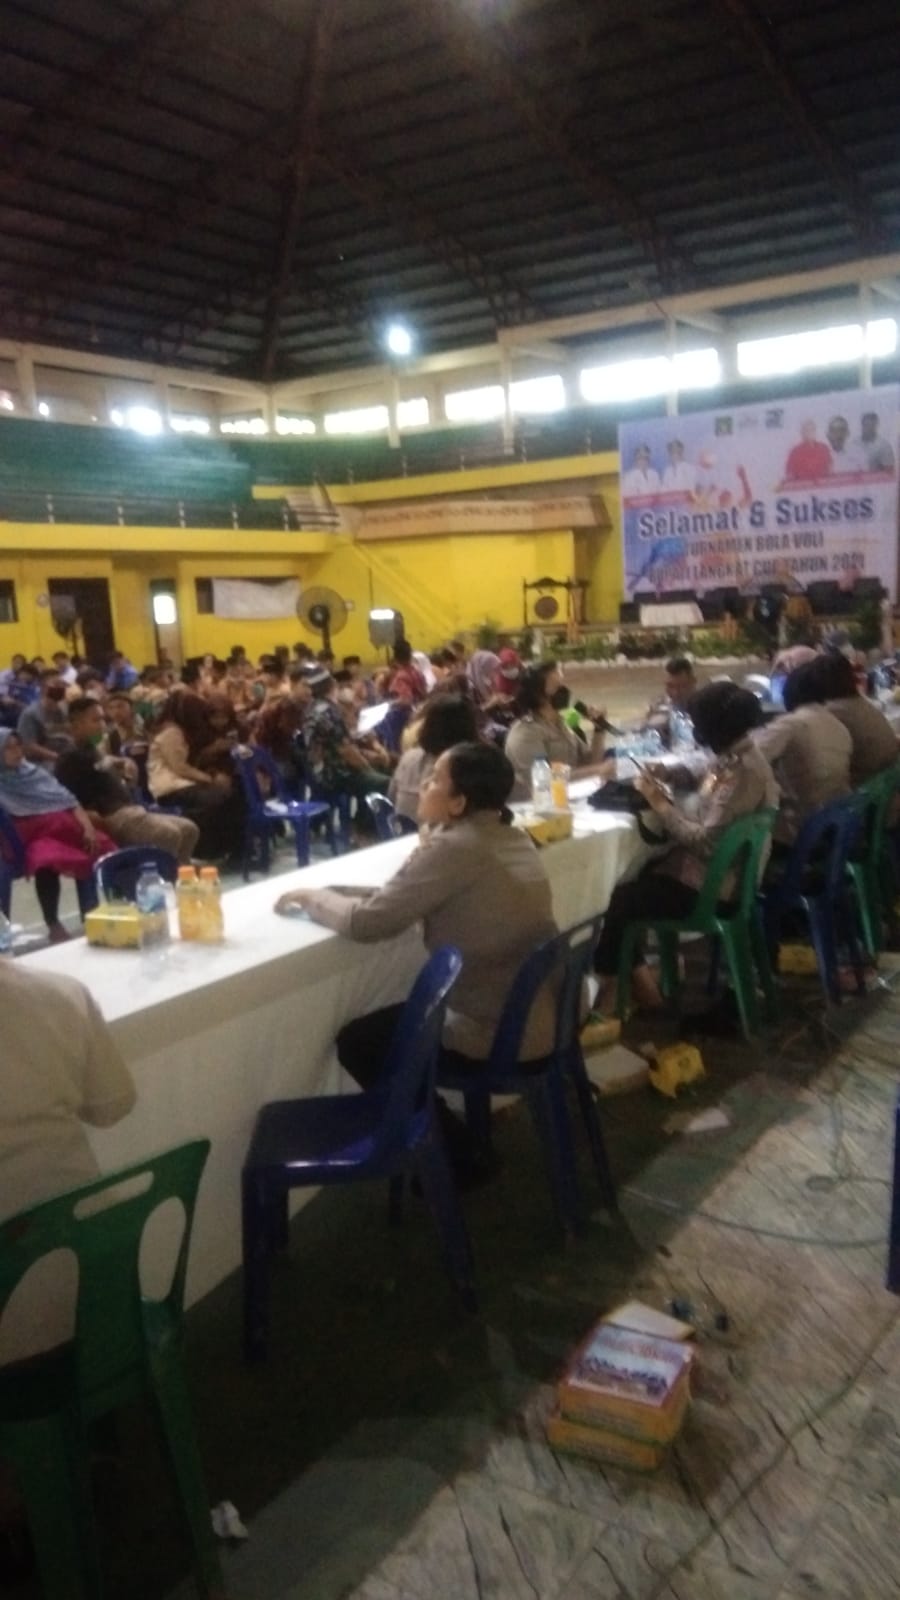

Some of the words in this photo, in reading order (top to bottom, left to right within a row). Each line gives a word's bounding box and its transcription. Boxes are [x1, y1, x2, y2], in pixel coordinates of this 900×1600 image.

[640, 507, 738, 538] Selamat
[749, 501, 765, 528] &
[776, 496, 873, 525] Sukses
[756, 534, 791, 553] BOLA
[793, 531, 824, 549] VOLI
[783, 554, 827, 573] TAHUN
